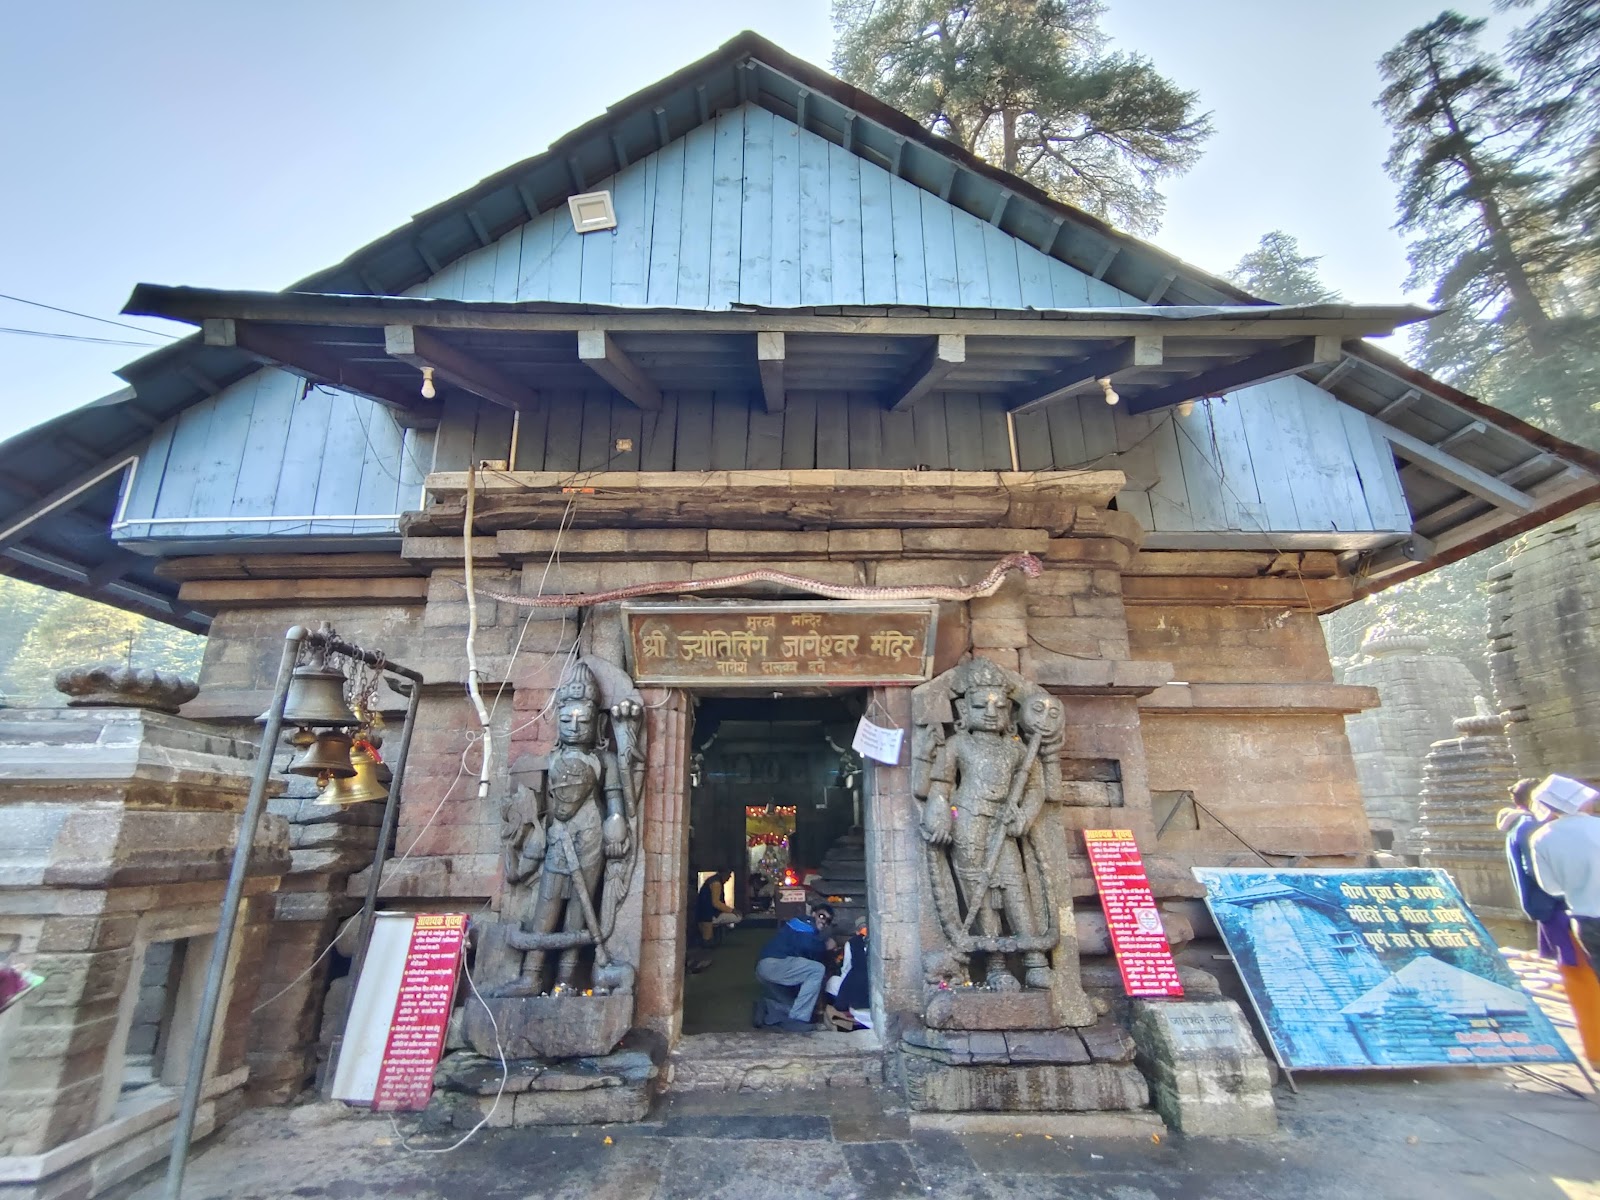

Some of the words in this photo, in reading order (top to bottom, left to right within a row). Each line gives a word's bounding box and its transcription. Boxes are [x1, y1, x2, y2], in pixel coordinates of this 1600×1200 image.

[641, 629, 668, 658] श्री
[781, 629, 860, 658] जागेश्वर
[869, 630, 916, 662] मंदिर
[1340, 882, 1368, 899] भोग
[1365, 885, 1395, 904] पूजा
[1392, 882, 1411, 899] के
[1409, 885, 1445, 900] समय
[416, 915, 445, 926] आवश्यक
[1346, 904, 1384, 923] मंदिरों
[1382, 905, 1400, 923] के
[1399, 905, 1434, 923] भीतर
[1431, 905, 1467, 923] प्रवेश
[1362, 929, 1392, 952] पूर्ण
[1409, 929, 1431, 948] से
[1425, 928, 1467, 948] वर्जित
[1459, 928, 1482, 947] है
